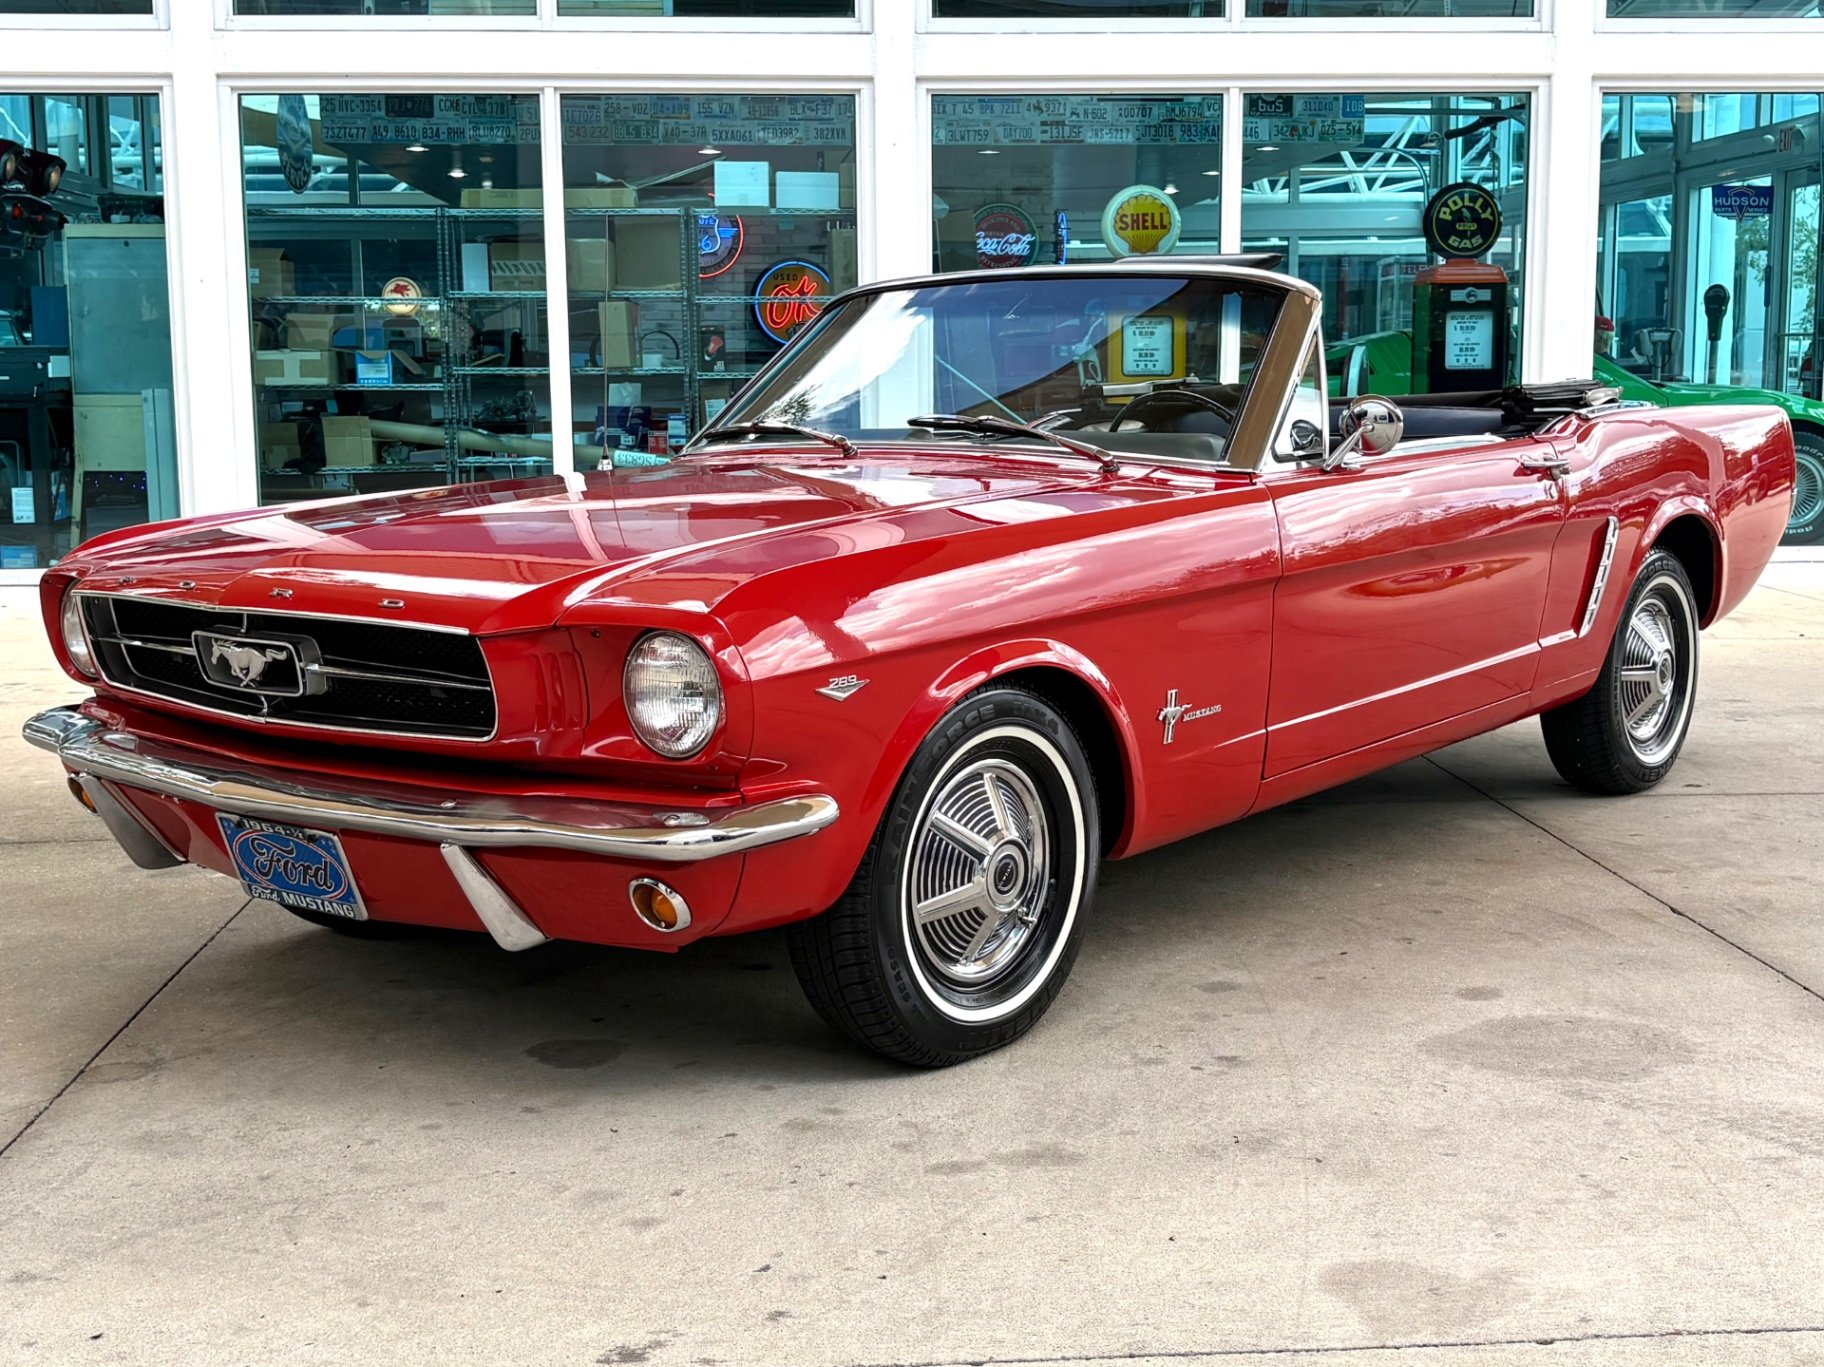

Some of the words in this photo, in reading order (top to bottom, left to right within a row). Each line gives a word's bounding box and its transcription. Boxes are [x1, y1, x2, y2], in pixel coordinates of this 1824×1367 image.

[422, 127, 465, 140] 834-RHH
[1438, 193, 1494, 221] POLLY
[1714, 196, 1770, 207] HUDSON
[1118, 212, 1168, 231] SHELL
[976, 232, 1036, 257] oca-Cola
[1447, 235, 1484, 249] GAS
[773, 273, 799, 282] USED
[767, 274, 820, 328] OK
[829, 674, 858, 689] 289
[249, 835, 335, 892] Ford
[283, 891, 354, 918] MUSTANG
